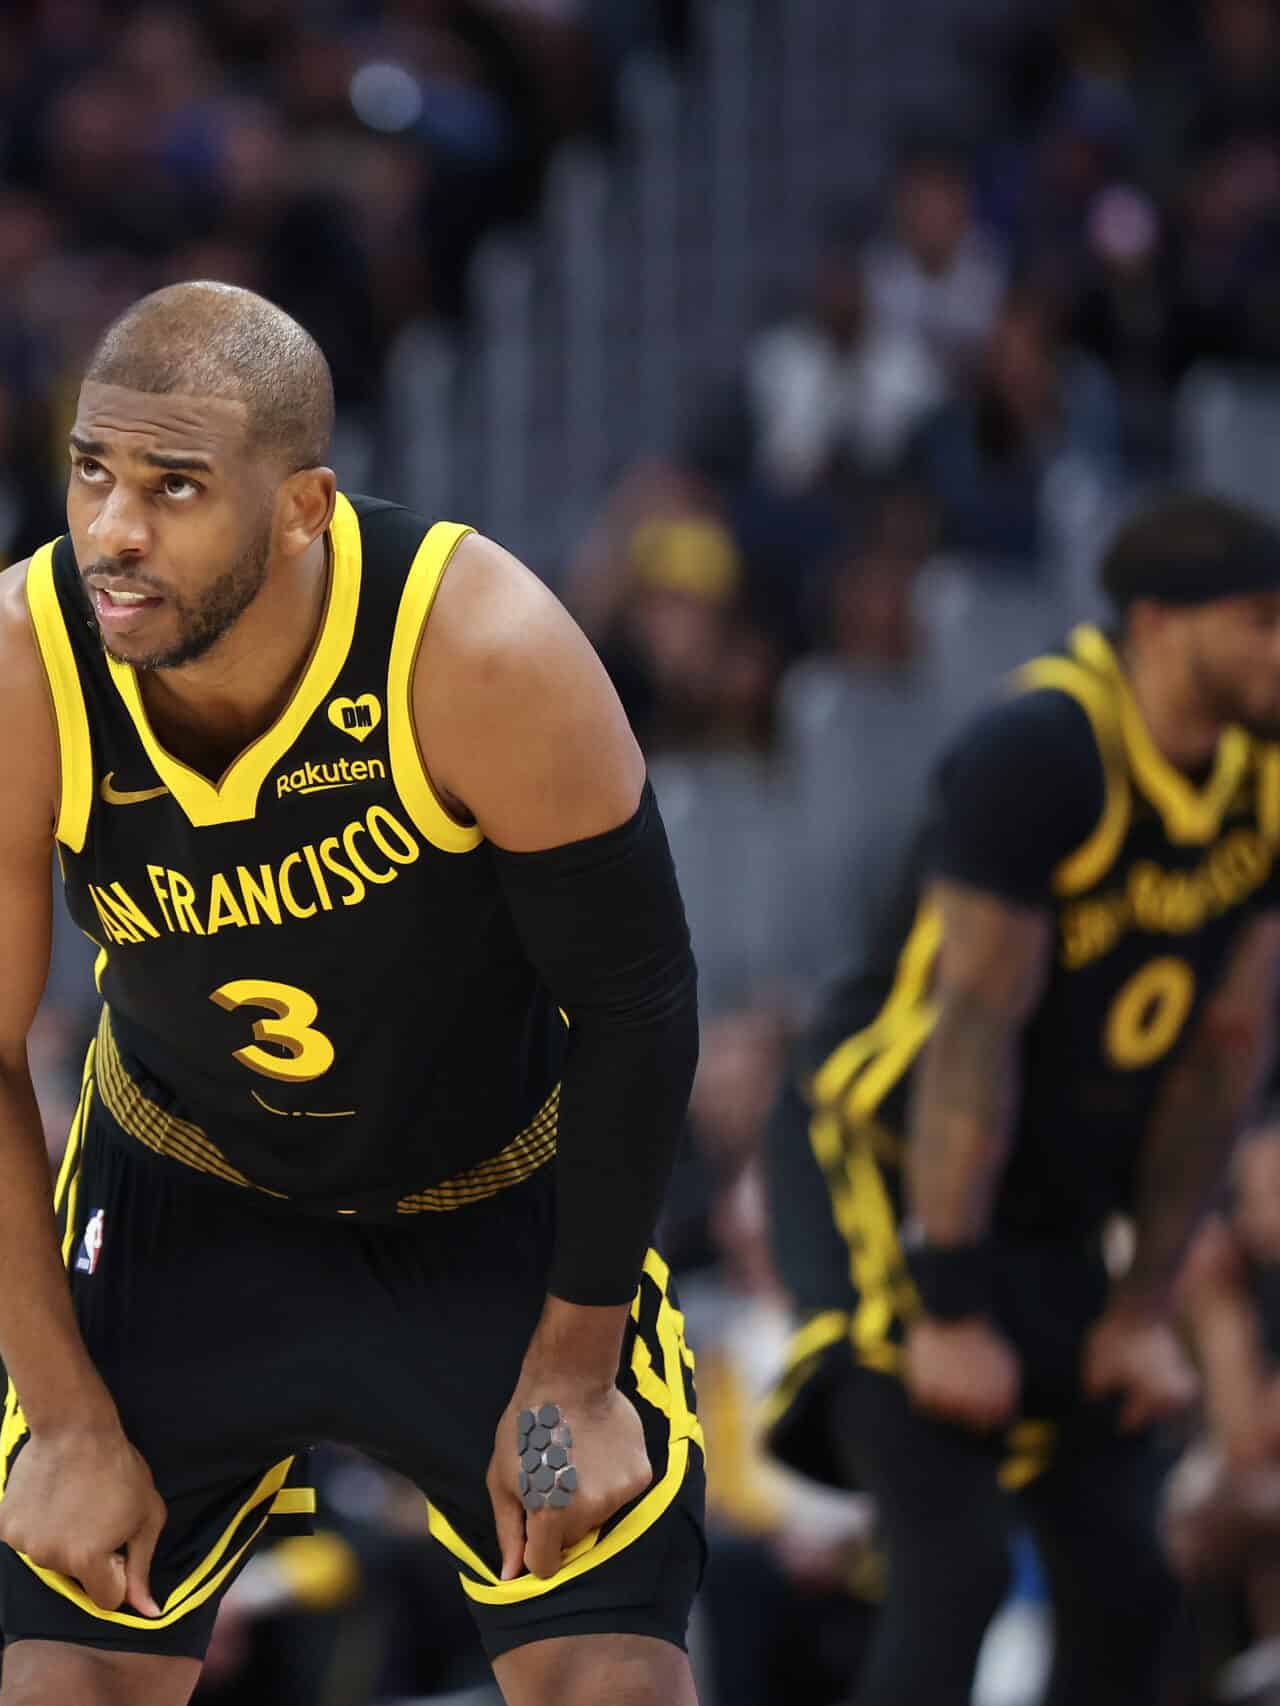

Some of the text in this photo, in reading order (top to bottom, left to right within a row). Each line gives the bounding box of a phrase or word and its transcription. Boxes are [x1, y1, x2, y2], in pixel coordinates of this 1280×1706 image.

[341, 705, 373, 729] DM
[276, 758, 385, 799] Rakuten
[87, 805, 420, 945] AN FRANCISCO
[209, 979, 334, 1082] 3
[1106, 958, 1193, 1071] 0
